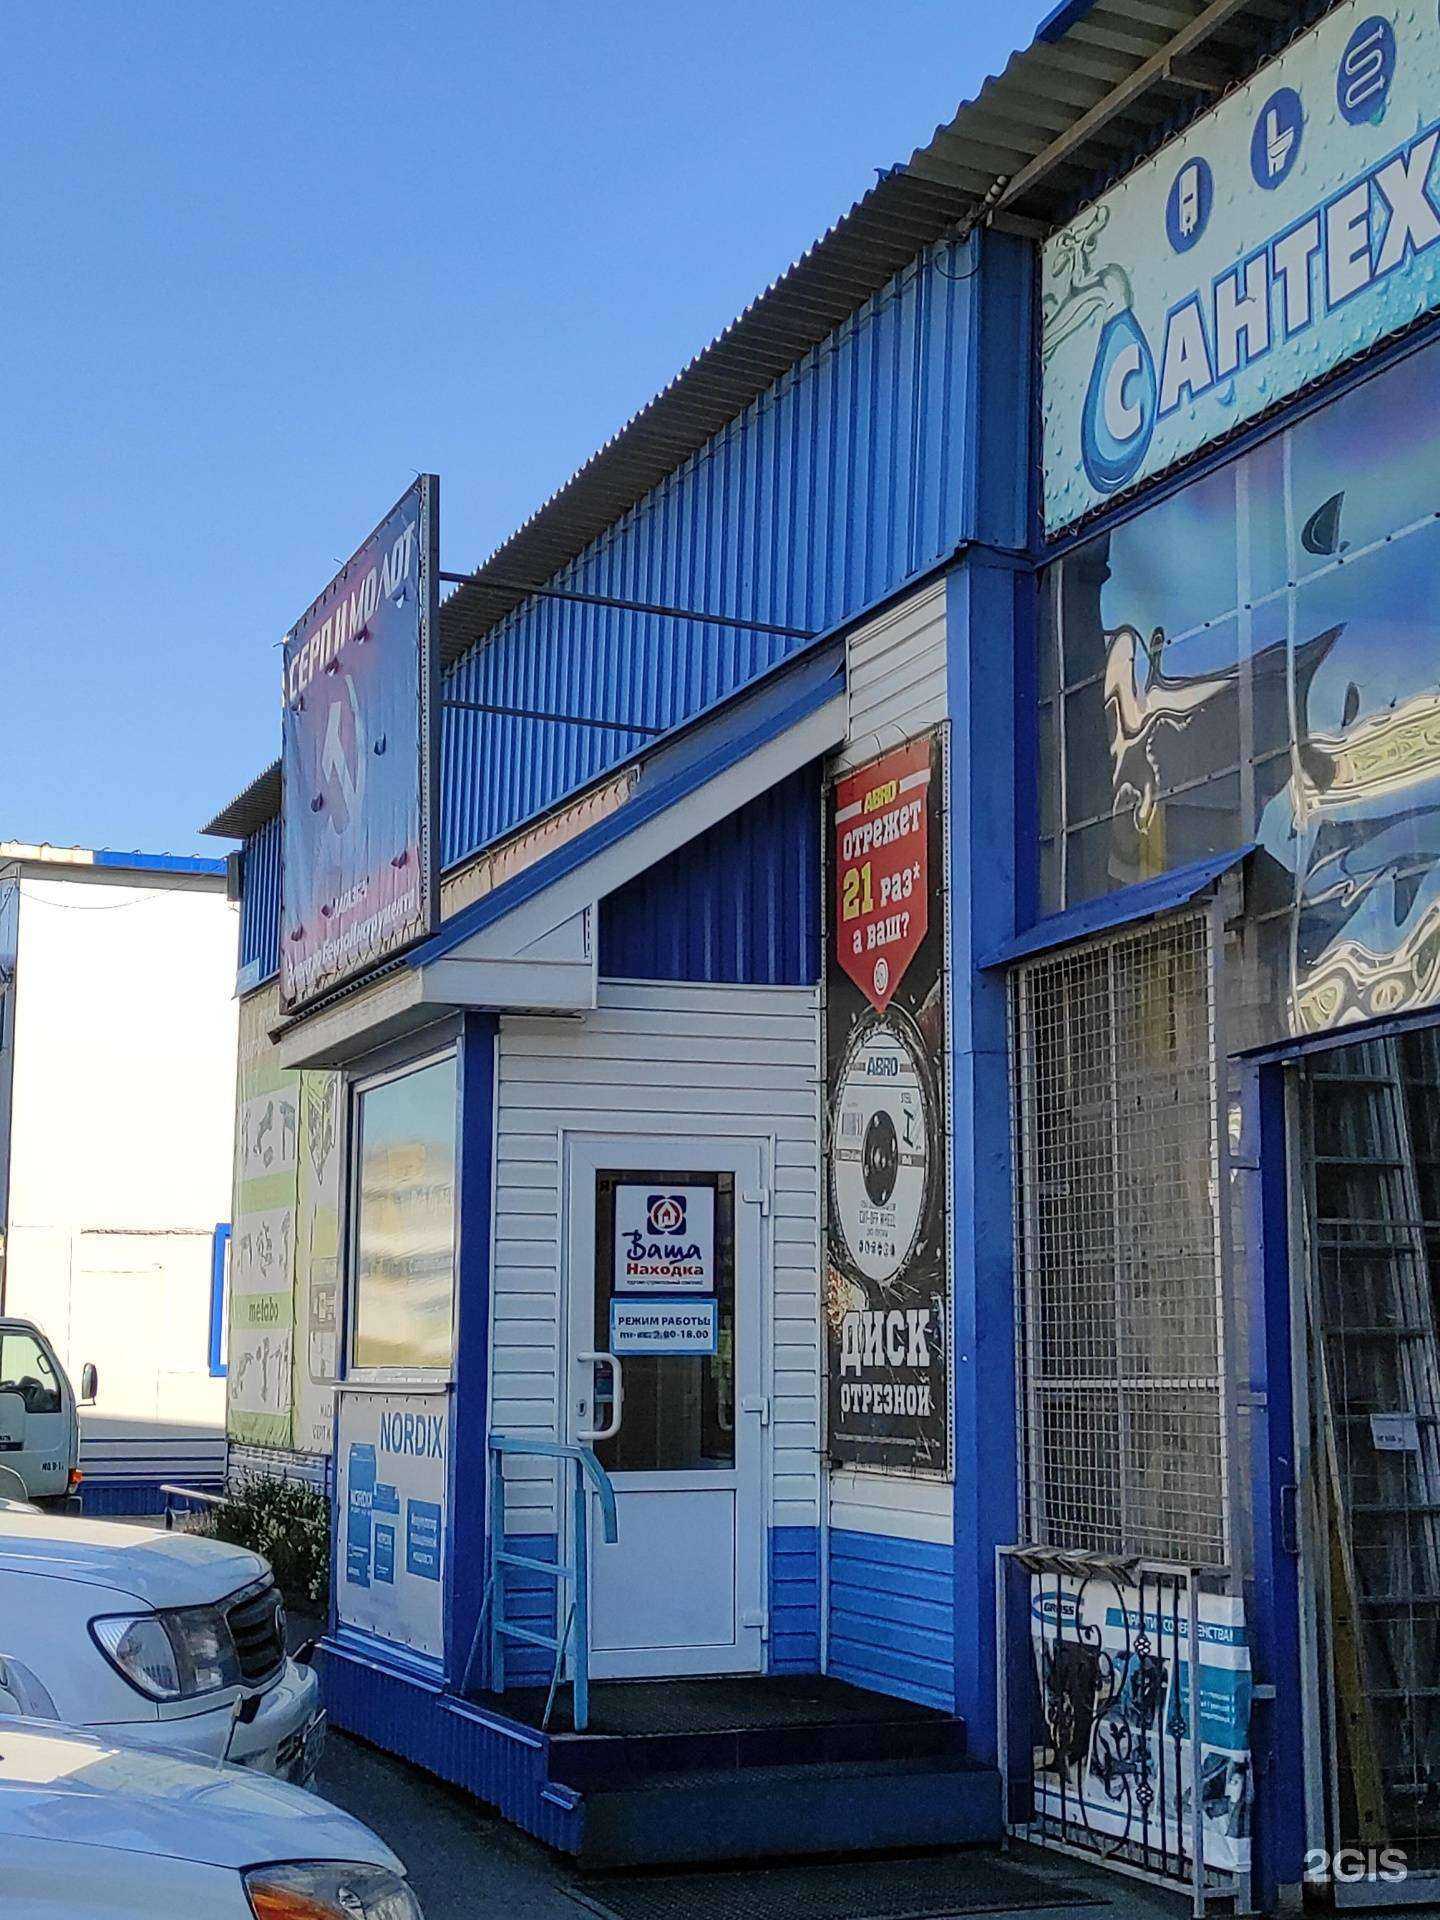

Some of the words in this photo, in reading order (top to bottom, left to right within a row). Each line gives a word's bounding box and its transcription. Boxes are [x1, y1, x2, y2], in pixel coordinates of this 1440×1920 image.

[289, 616, 333, 698] СЕРП
[334, 599, 348, 655] И
[349, 521, 416, 640] МОЛОТ
[843, 861, 874, 922] 21
[867, 1057, 899, 1076] ABRO
[622, 1229, 702, 1265] Ваша
[626, 1263, 704, 1277] Находка
[249, 1297, 279, 1322] metabo
[618, 1317, 659, 1326] РЕЖИМ
[661, 1317, 711, 1326] РАБОТЫ
[840, 1309, 930, 1376] ДИСК
[840, 1371, 931, 1416] ОТРЕЗНОЙ
[381, 1412, 443, 1458] NORDIX
[1043, 1602, 1075, 1615] GRSS
